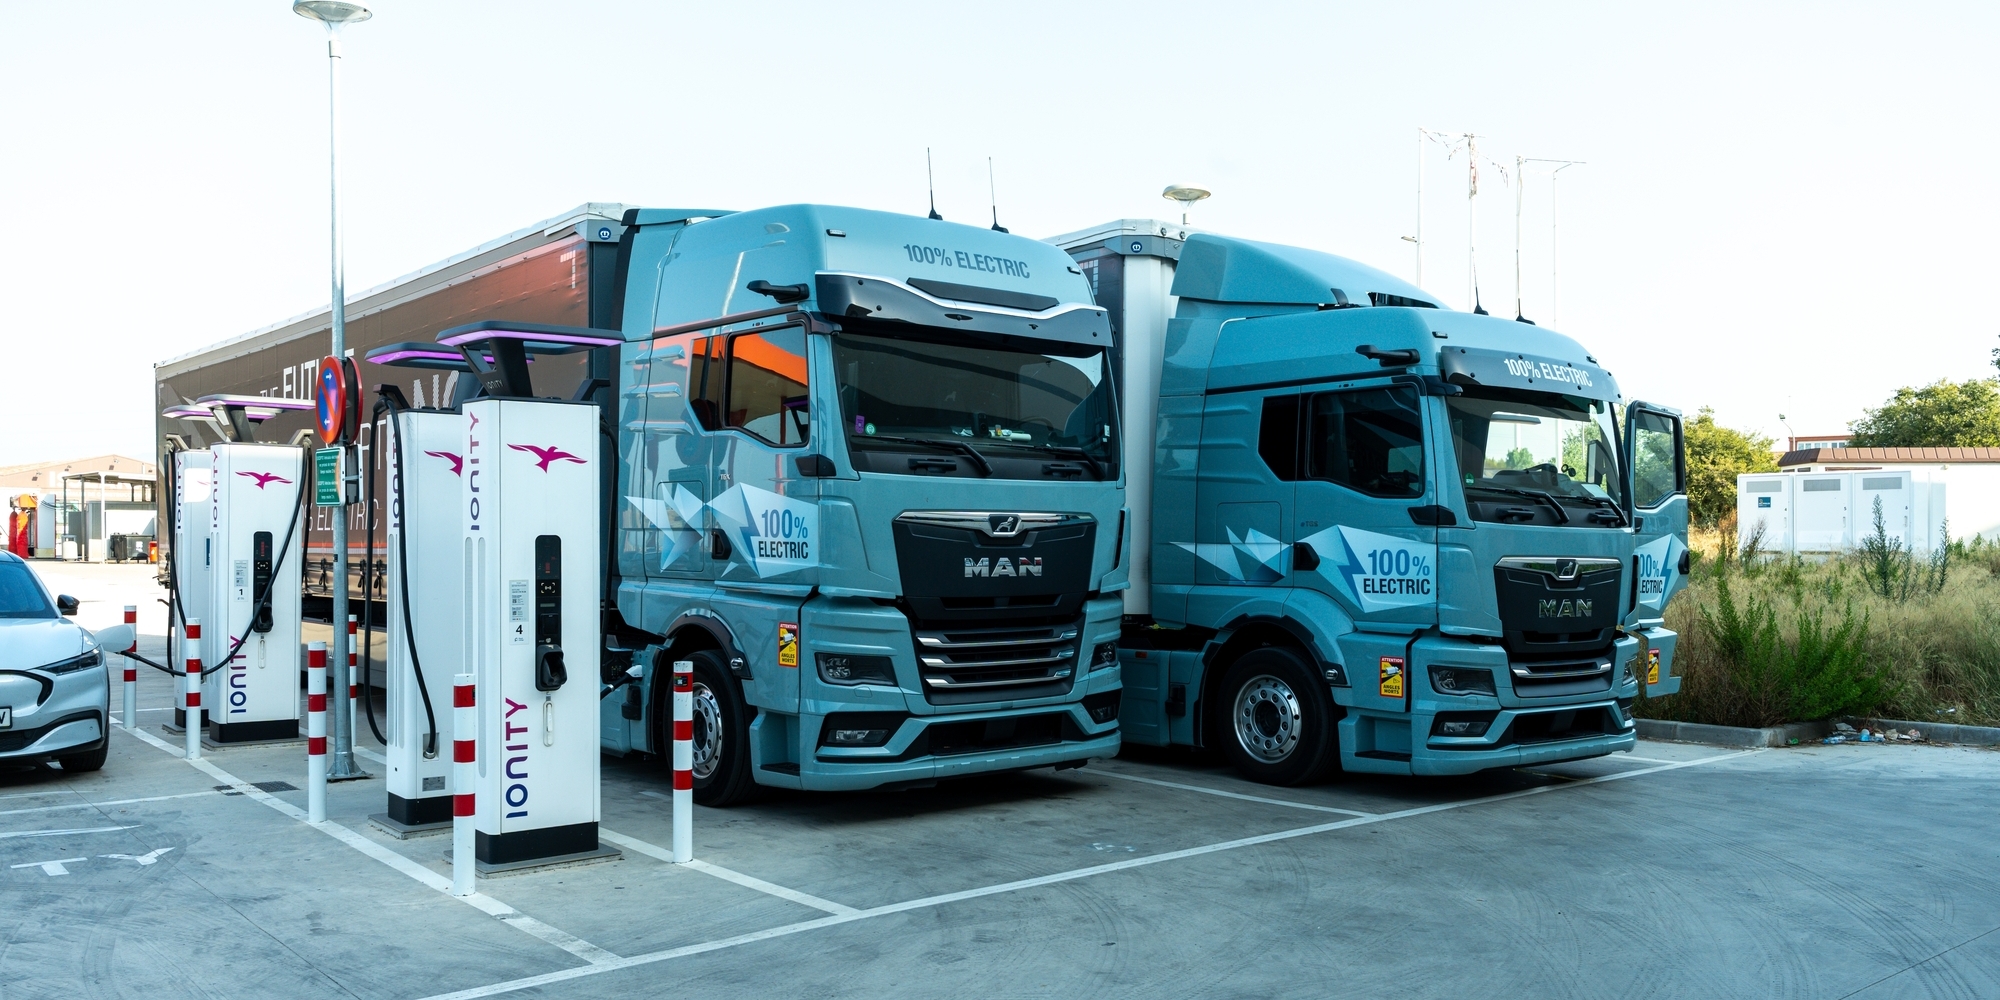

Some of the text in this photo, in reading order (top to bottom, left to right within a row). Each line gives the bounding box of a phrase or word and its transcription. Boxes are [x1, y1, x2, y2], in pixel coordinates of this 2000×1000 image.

[904, 244, 1030, 279] 100% ELECTRIC
[1504, 358, 1592, 387] 100% ELECTRIC
[470, 411, 480, 531] IONITY
[761, 509, 808, 540] 100%
[758, 541, 809, 559] ELECTRIC
[964, 557, 1042, 578] MAN
[1368, 549, 1430, 577] 100%
[1640, 553, 1659, 578] 00%
[239, 588, 243, 596] 1
[1363, 578, 1430, 595] ELECTRIC
[1640, 579, 1663, 594] ECTRIC
[1539, 599, 1592, 618] MAN
[516, 624, 523, 635] 4
[230, 635, 247, 714] IONITY
[505, 697, 528, 819] IONITY
